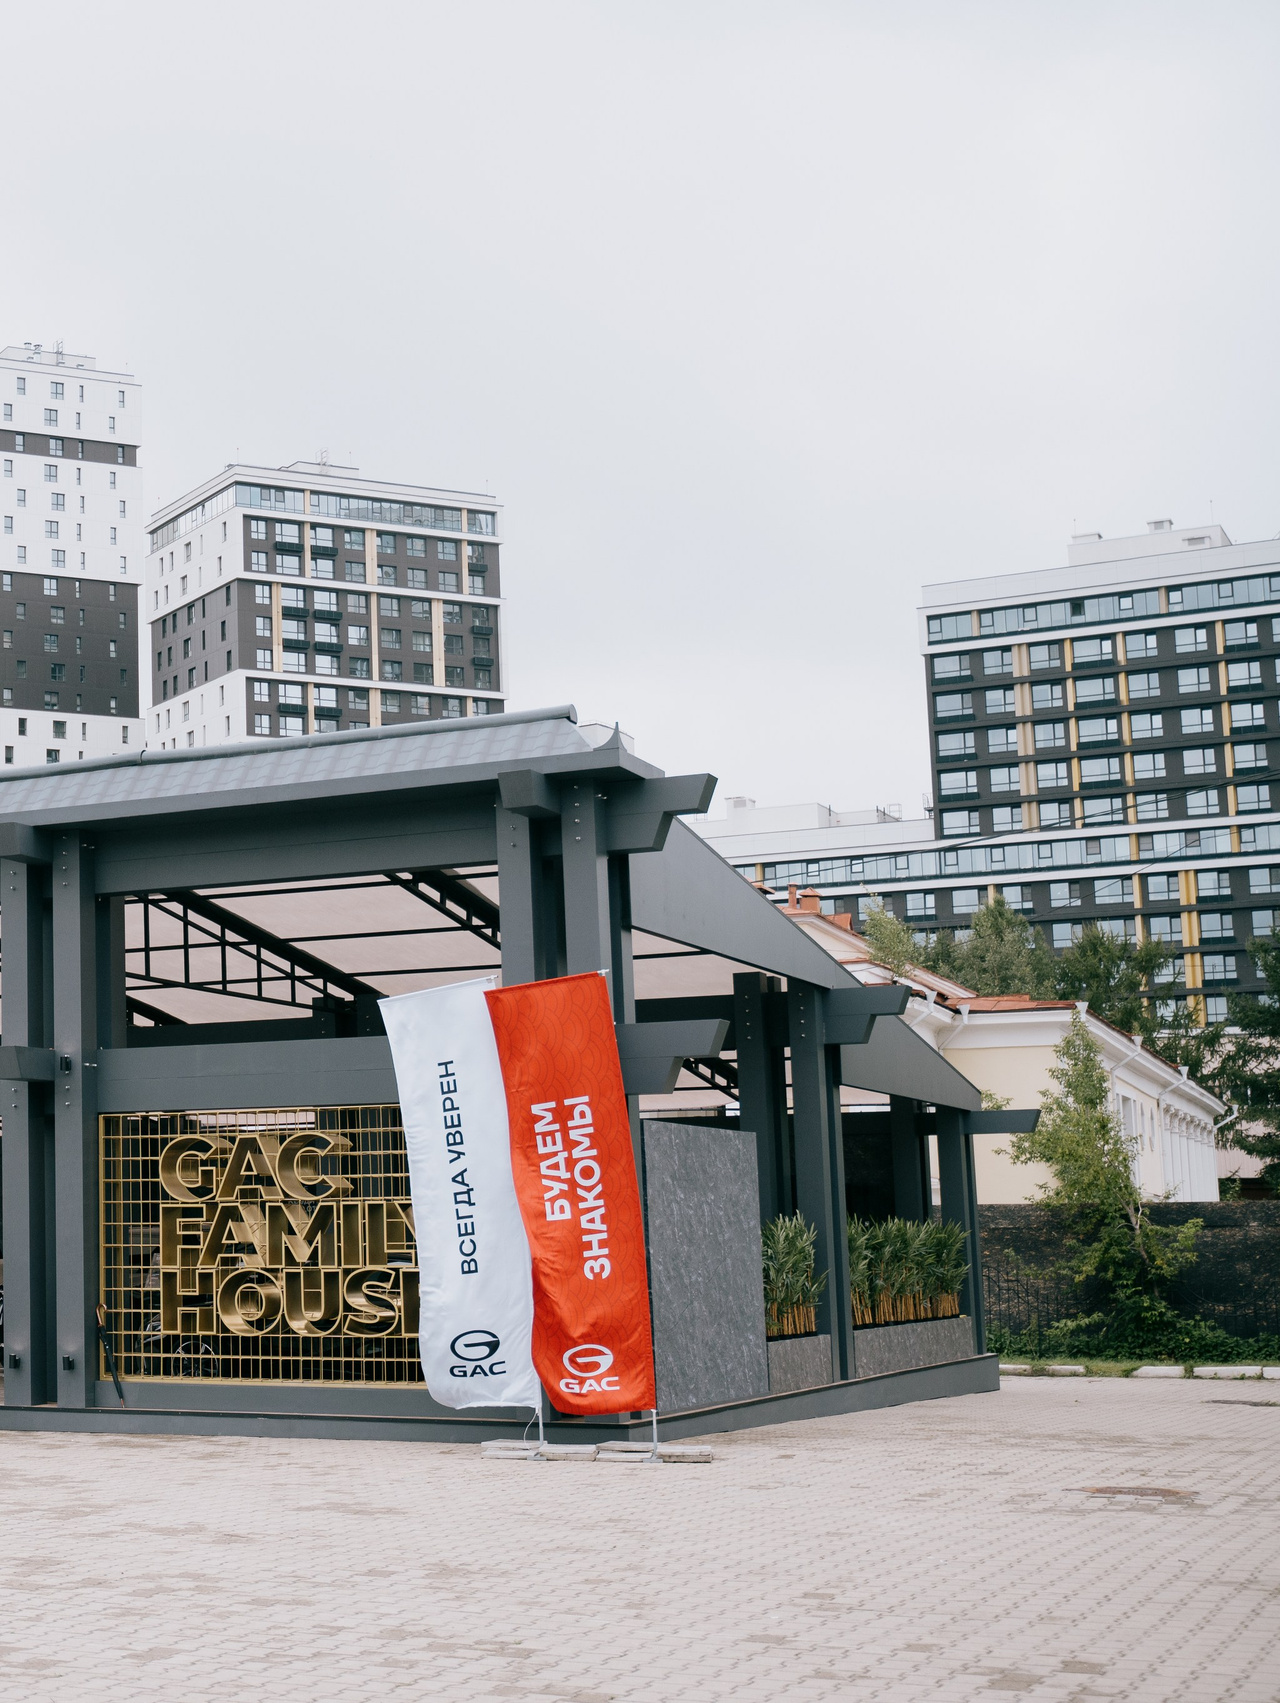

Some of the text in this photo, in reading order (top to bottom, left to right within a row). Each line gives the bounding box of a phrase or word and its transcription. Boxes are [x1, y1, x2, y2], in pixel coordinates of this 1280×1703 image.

[159, 1131, 350, 1203] GAC
[437, 1060, 479, 1275] ВСЕГДА УВЕРЕН
[530, 1101, 572, 1222] БУДЕМ
[563, 1095, 611, 1281] ЗНАКОМЫ
[449, 1360, 507, 1378] GAC
[559, 1376, 621, 1394] GAC
